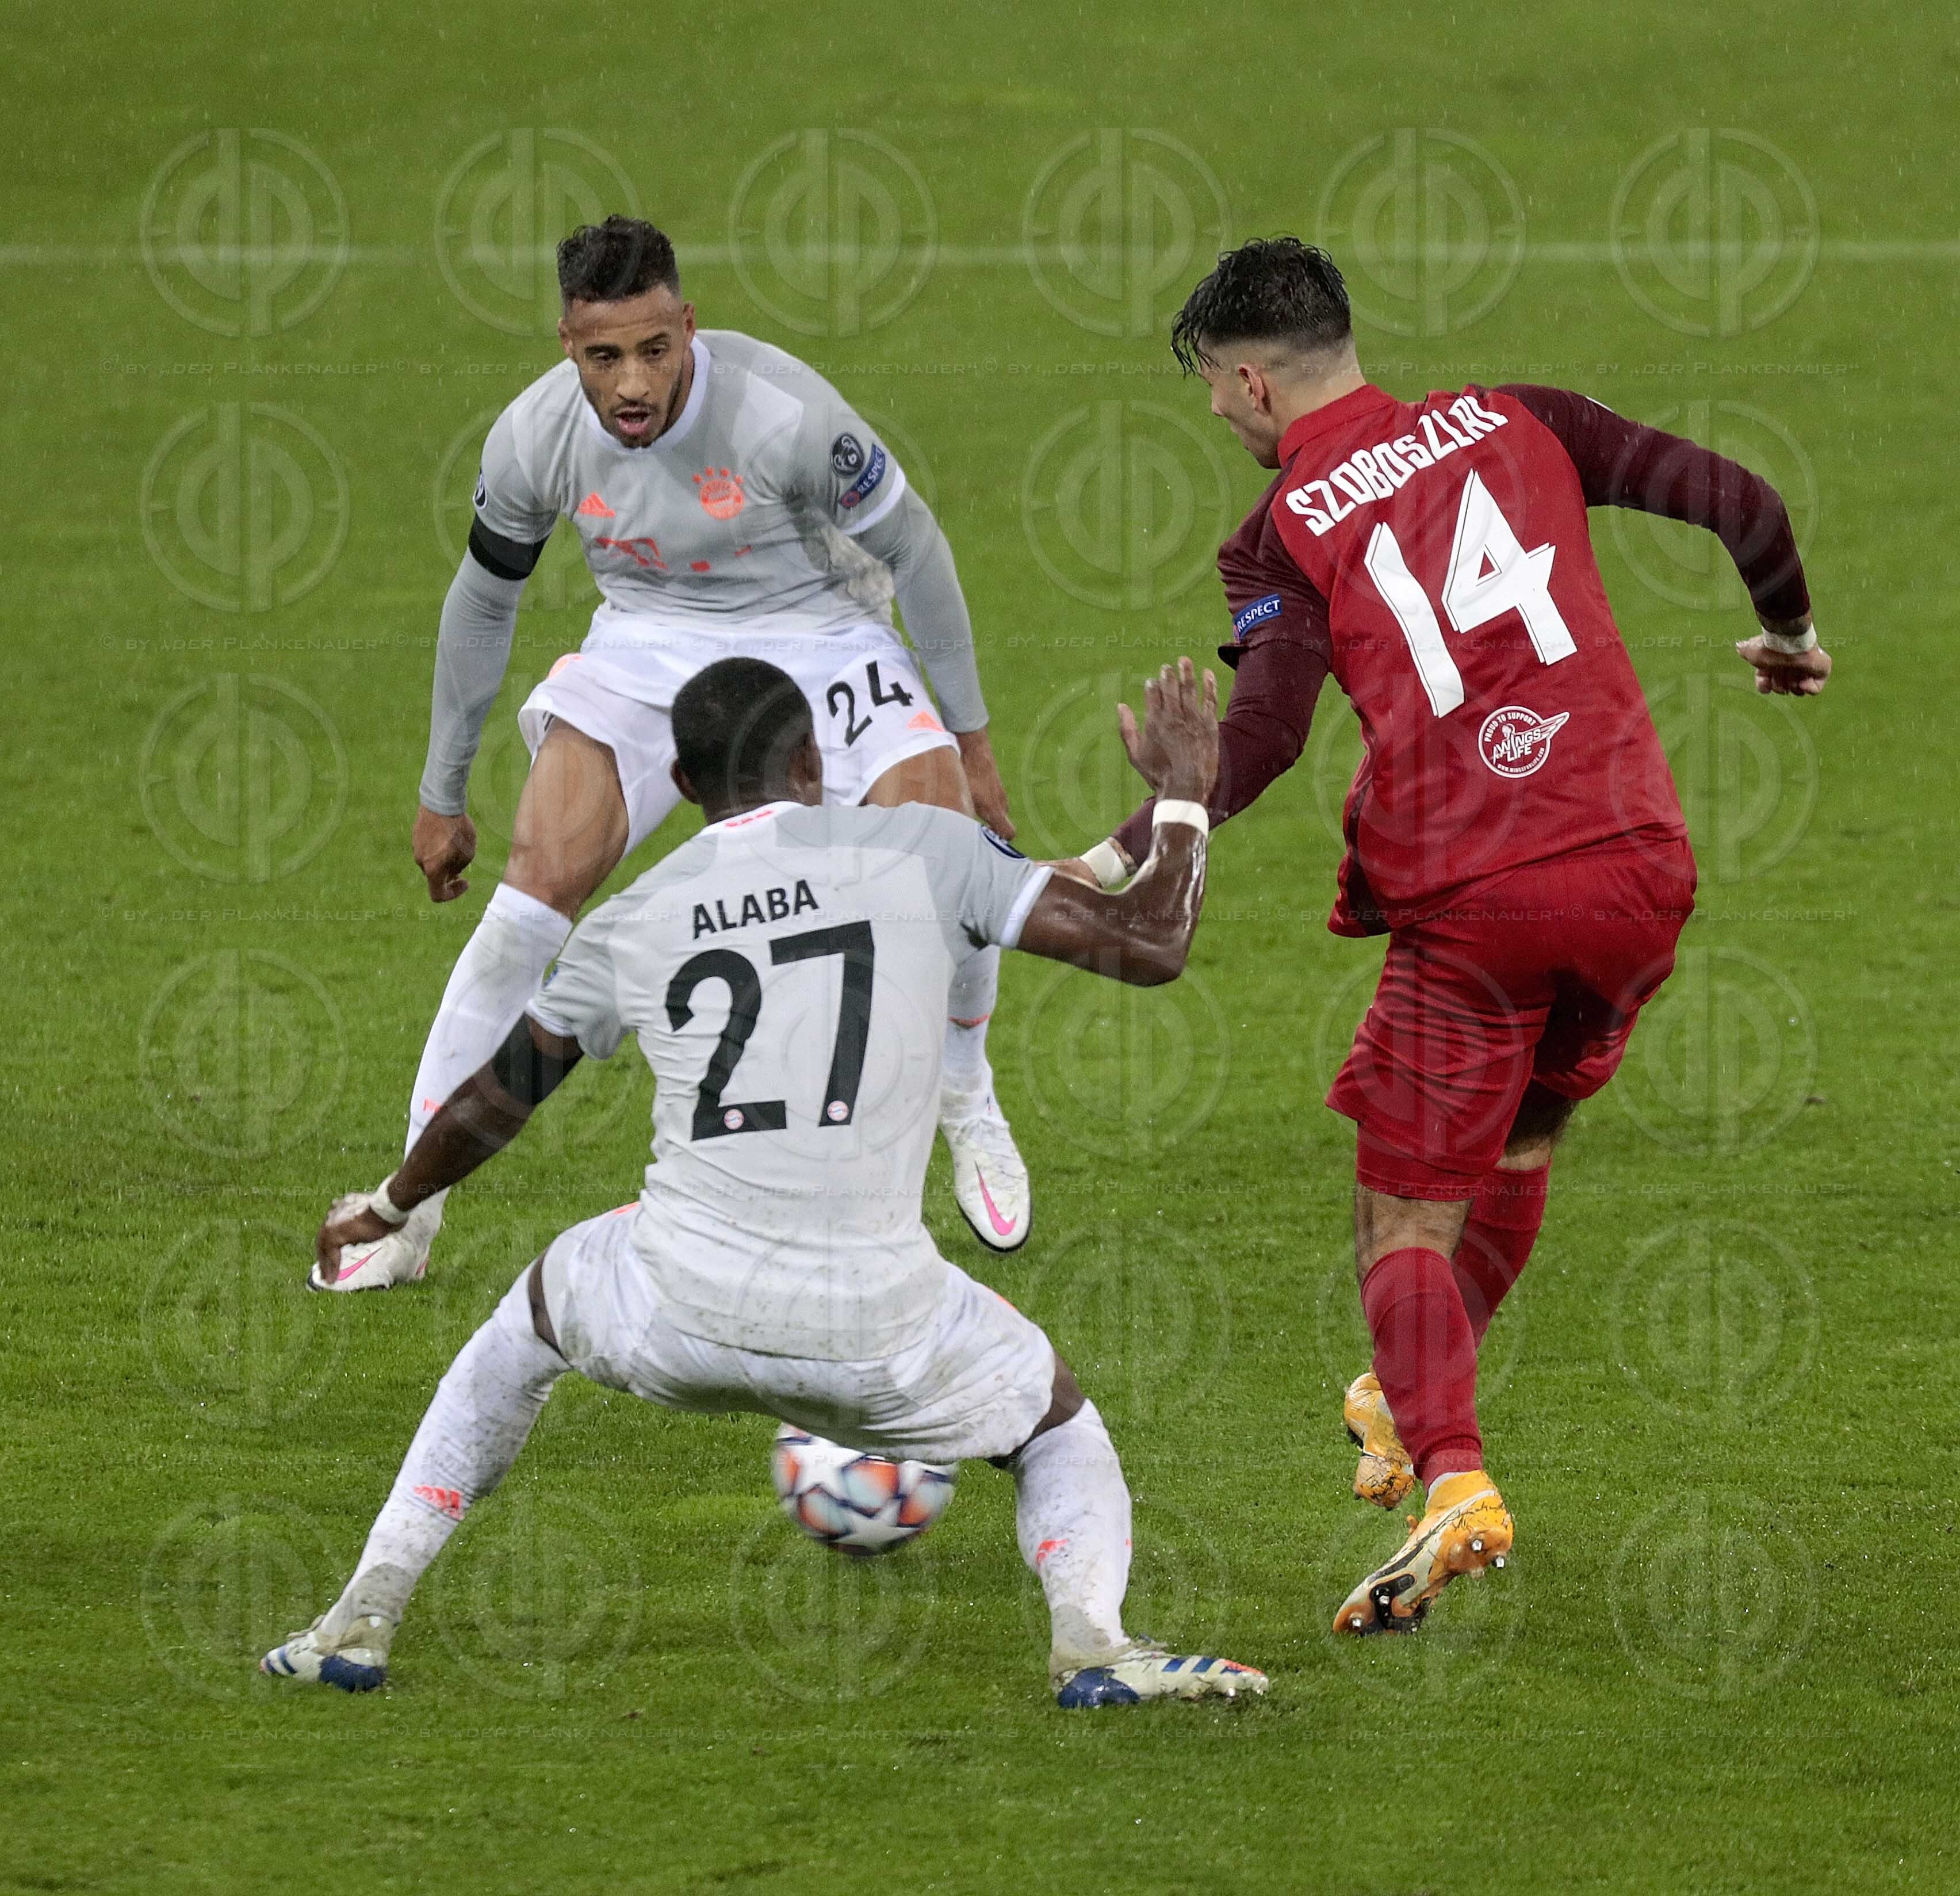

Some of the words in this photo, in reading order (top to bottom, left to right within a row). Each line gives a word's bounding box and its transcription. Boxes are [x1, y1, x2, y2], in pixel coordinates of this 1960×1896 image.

[858, 446, 883, 494] RESPECT
[1285, 395, 1509, 536] SZOBOSZLAI
[1237, 599, 1280, 633] RESPECT
[1364, 468, 1578, 718] 14
[826, 660, 914, 747] 24
[1484, 720, 1499, 742] PROUD
[1496, 714, 1507, 723] TO
[1507, 712, 1537, 726] SUPPORT
[1507, 742, 1532, 762] LIFE
[692, 880, 819, 939] ALABA
[665, 920, 874, 1141] 27
